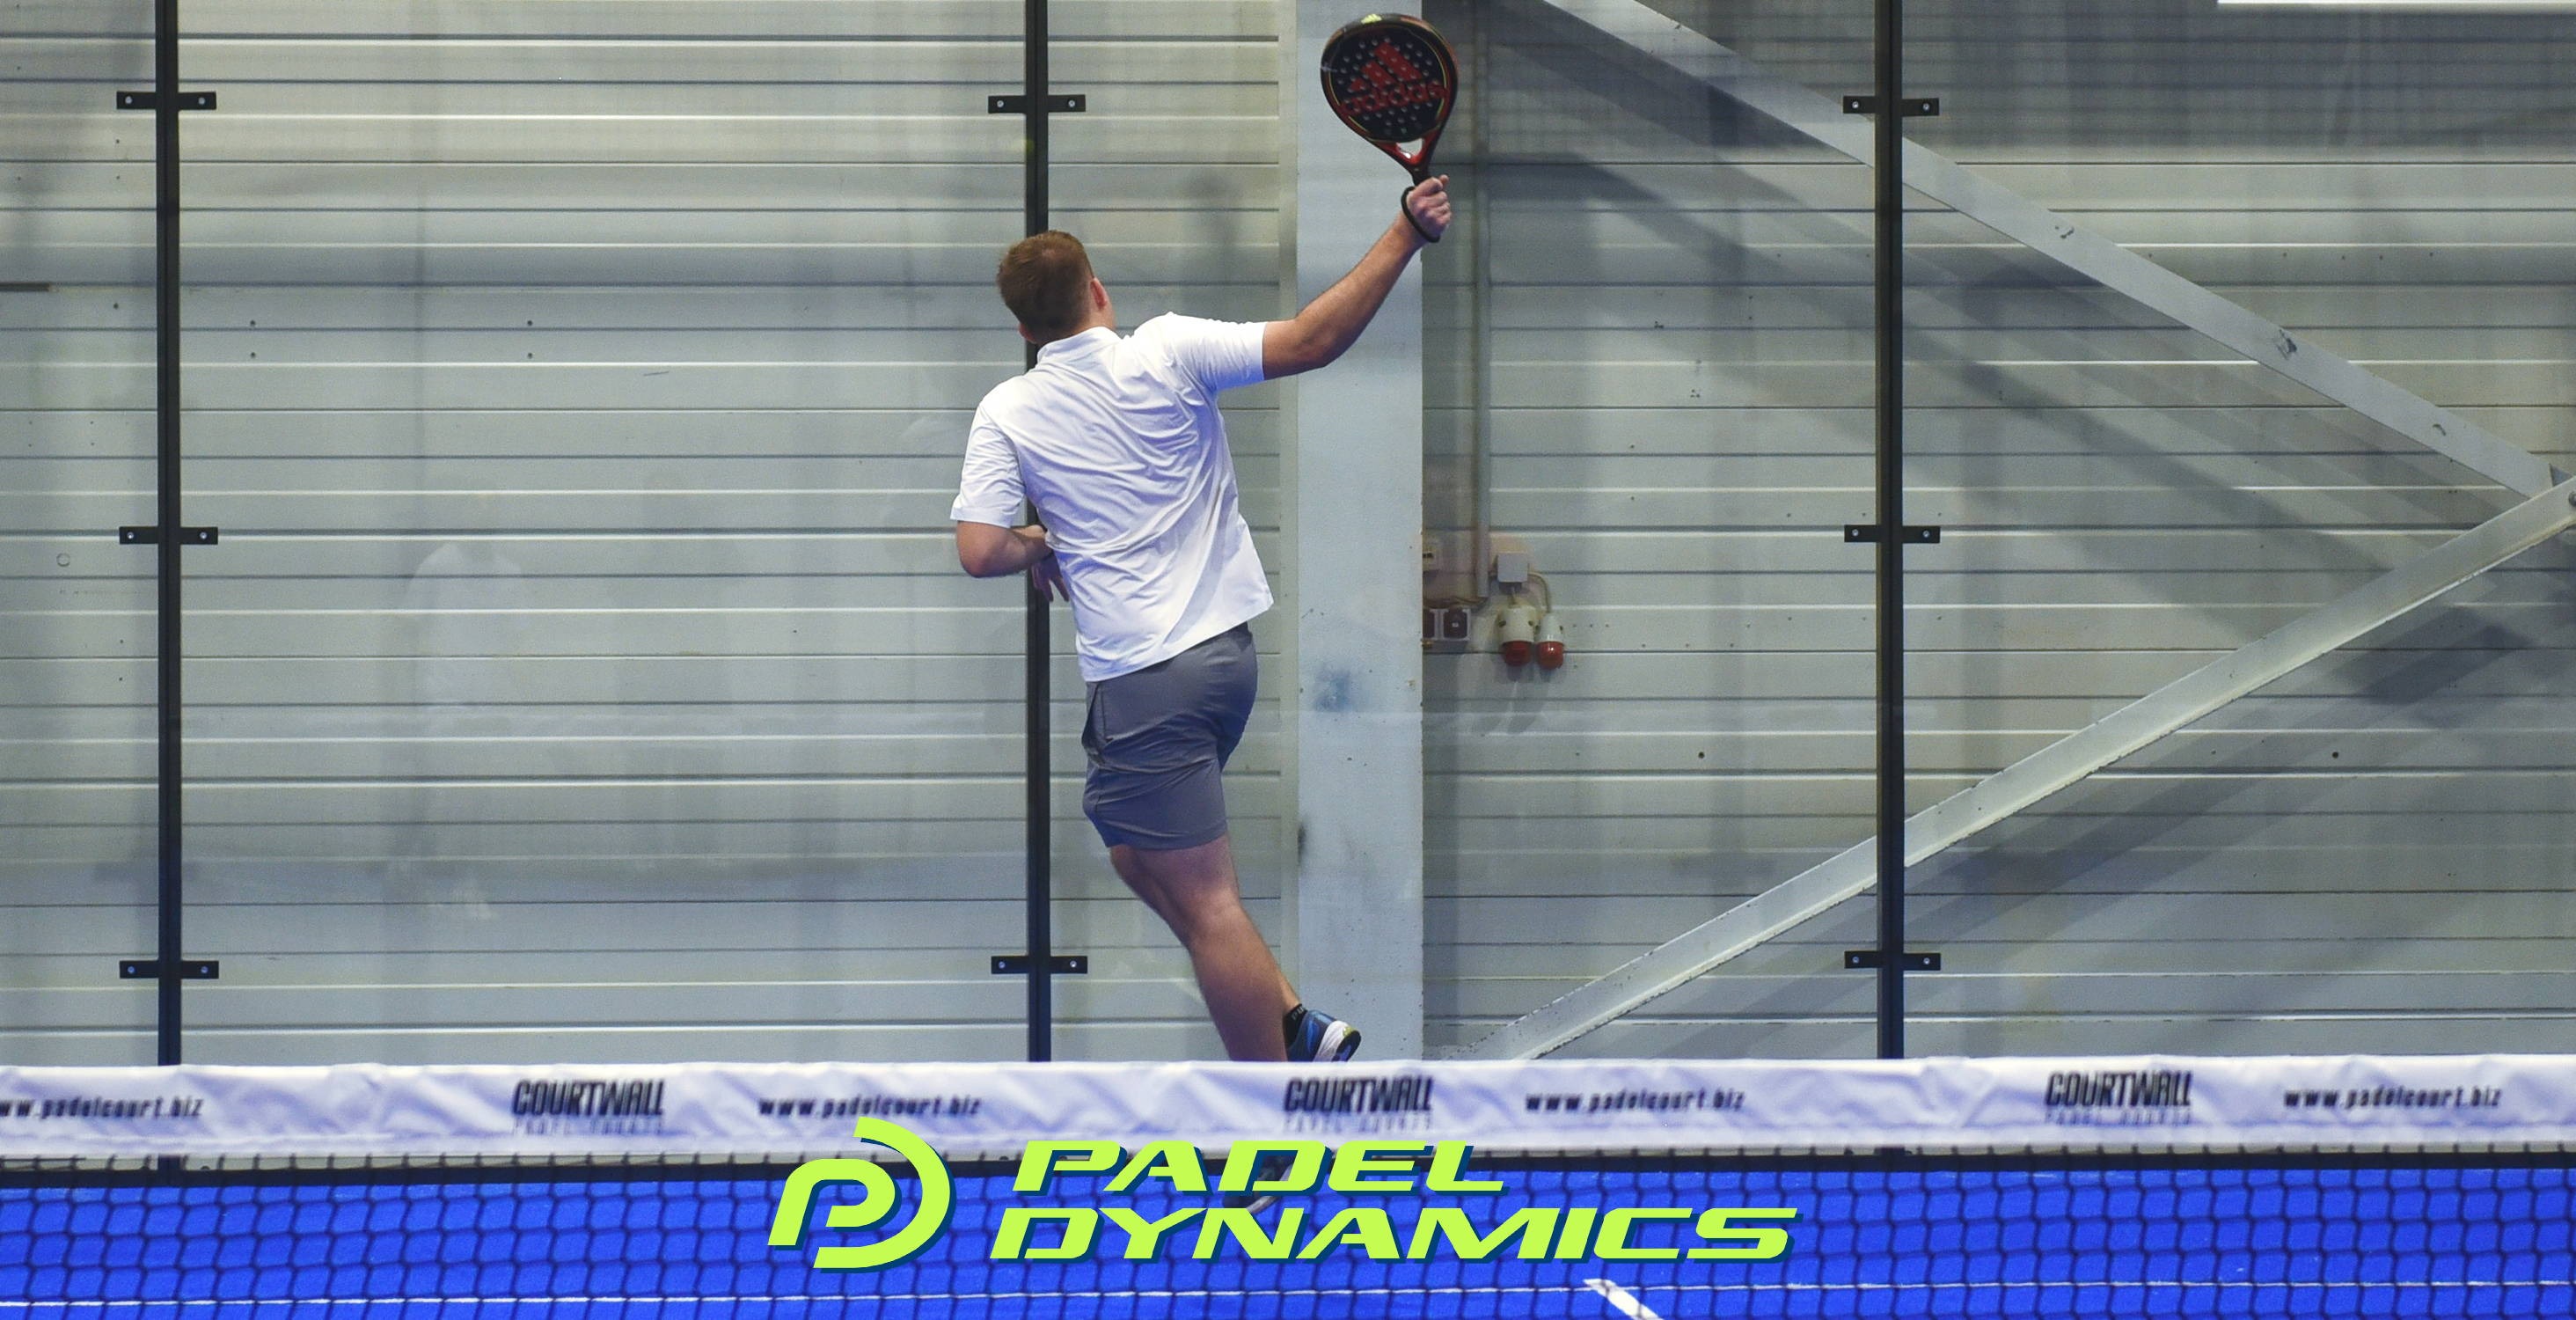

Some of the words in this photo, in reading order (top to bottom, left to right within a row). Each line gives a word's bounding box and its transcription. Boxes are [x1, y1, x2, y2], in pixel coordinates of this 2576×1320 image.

[514, 1078, 664, 1115] COURTWALL
[1284, 1075, 1432, 1111] COURTWALL
[1526, 1087, 1745, 1113] www.padelcourt.biz
[2045, 1070, 2192, 1106] COURTWALL
[2284, 1085, 2502, 1110] www.padelcourt.biz
[758, 1095, 982, 1118] www.padelcourt.biz
